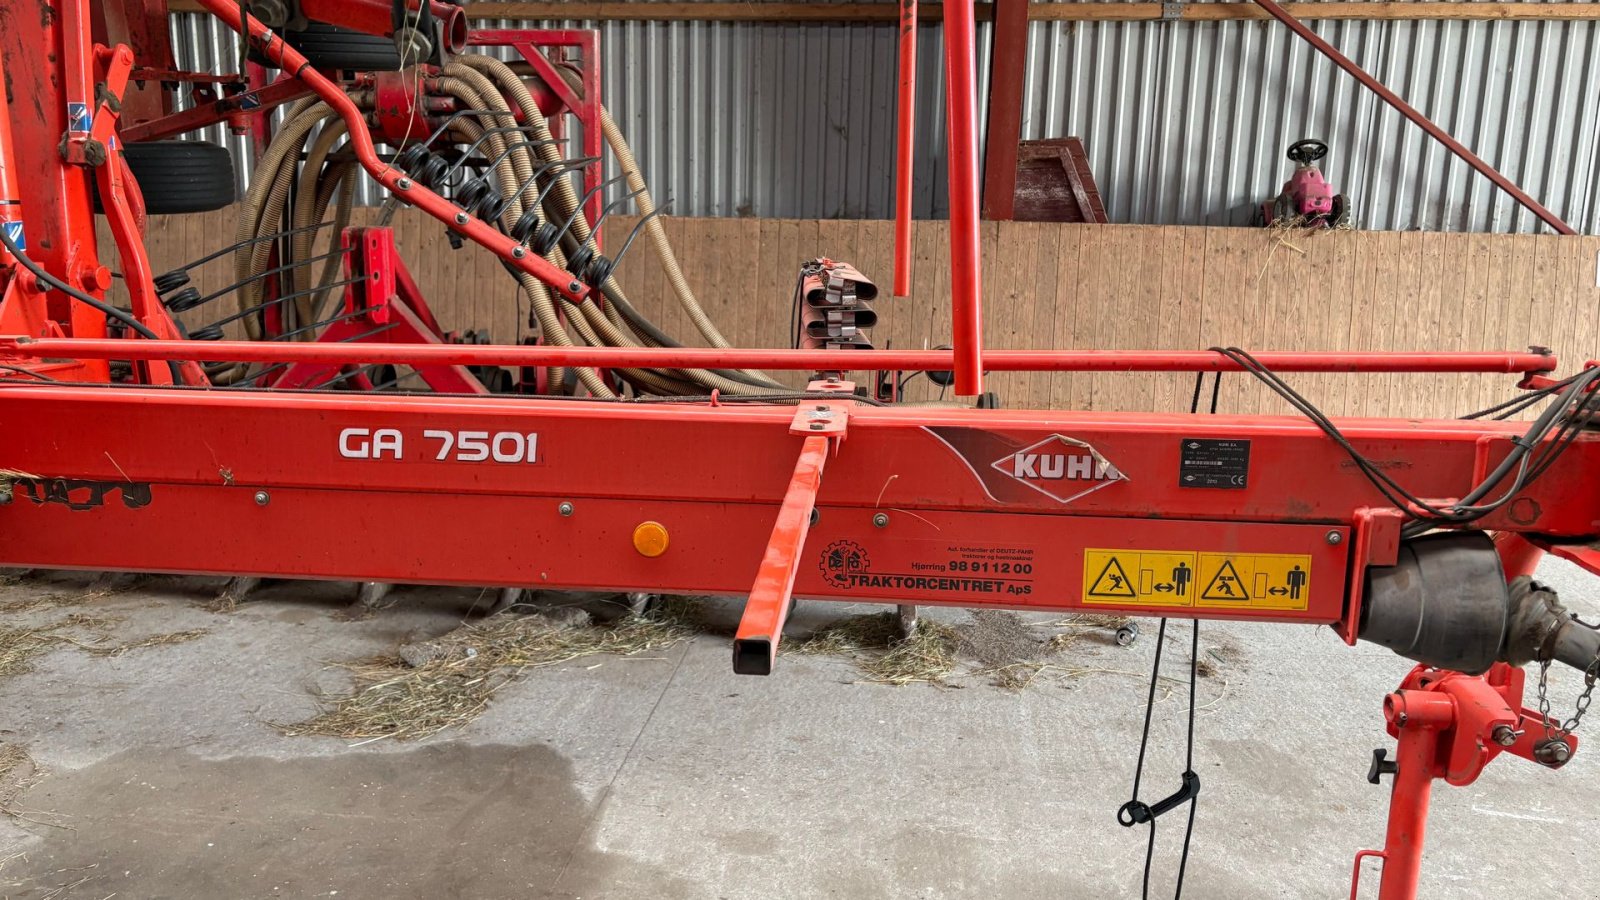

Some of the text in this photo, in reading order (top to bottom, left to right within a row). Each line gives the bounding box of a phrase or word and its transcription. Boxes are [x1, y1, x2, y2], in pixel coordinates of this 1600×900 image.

[339, 428, 538, 463] GA 7501
[911, 562, 946, 572] Hjørring
[848, 575, 1033, 596] TRAKTORCENTRET ApS
